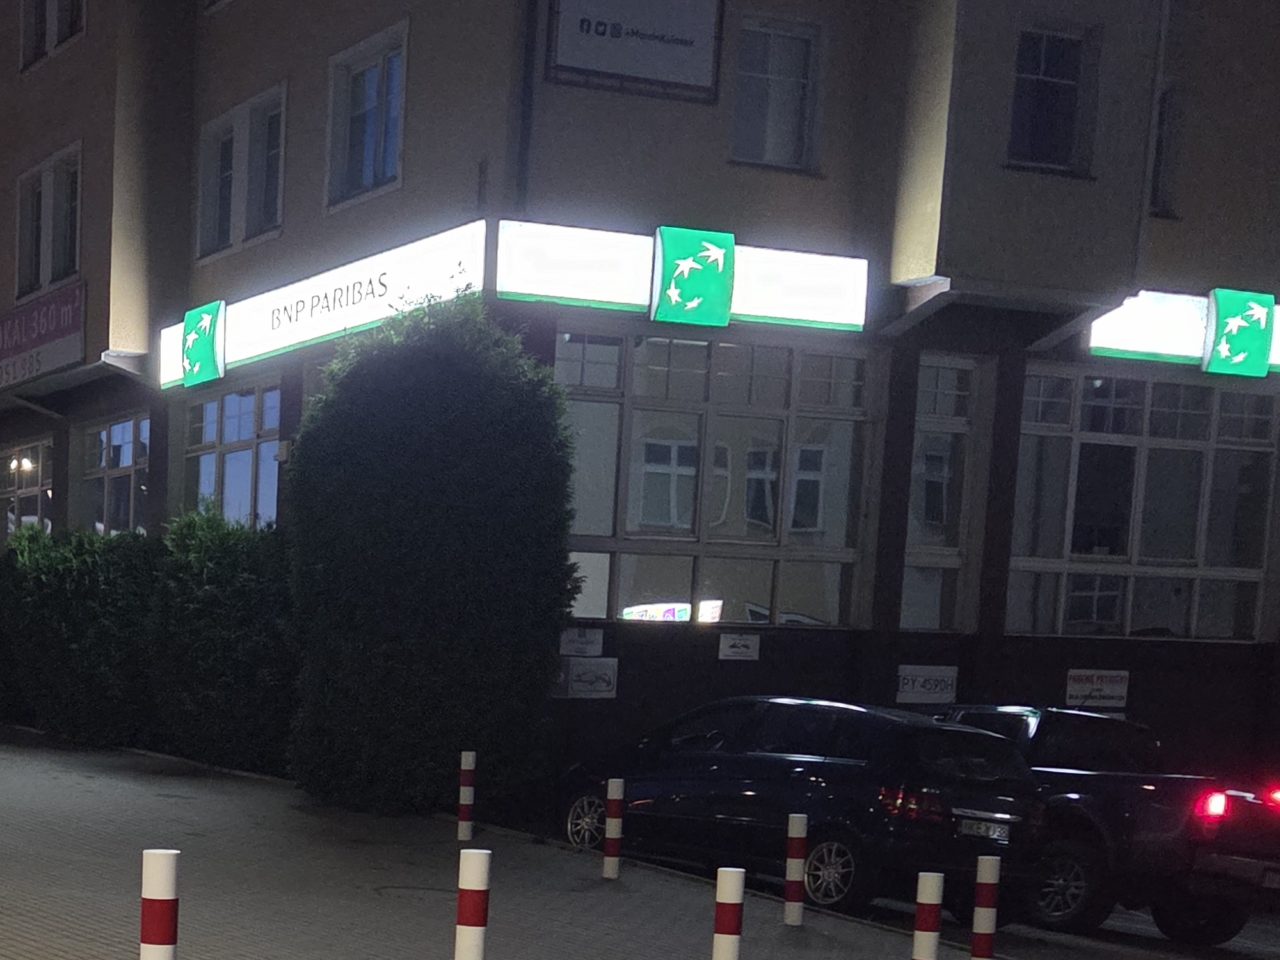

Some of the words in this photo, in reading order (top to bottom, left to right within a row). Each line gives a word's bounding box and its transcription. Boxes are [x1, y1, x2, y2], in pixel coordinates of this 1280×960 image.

[30, 303, 57, 339] 360
[270, 299, 306, 331] BNP
[310, 272, 387, 317] PARIBAS
